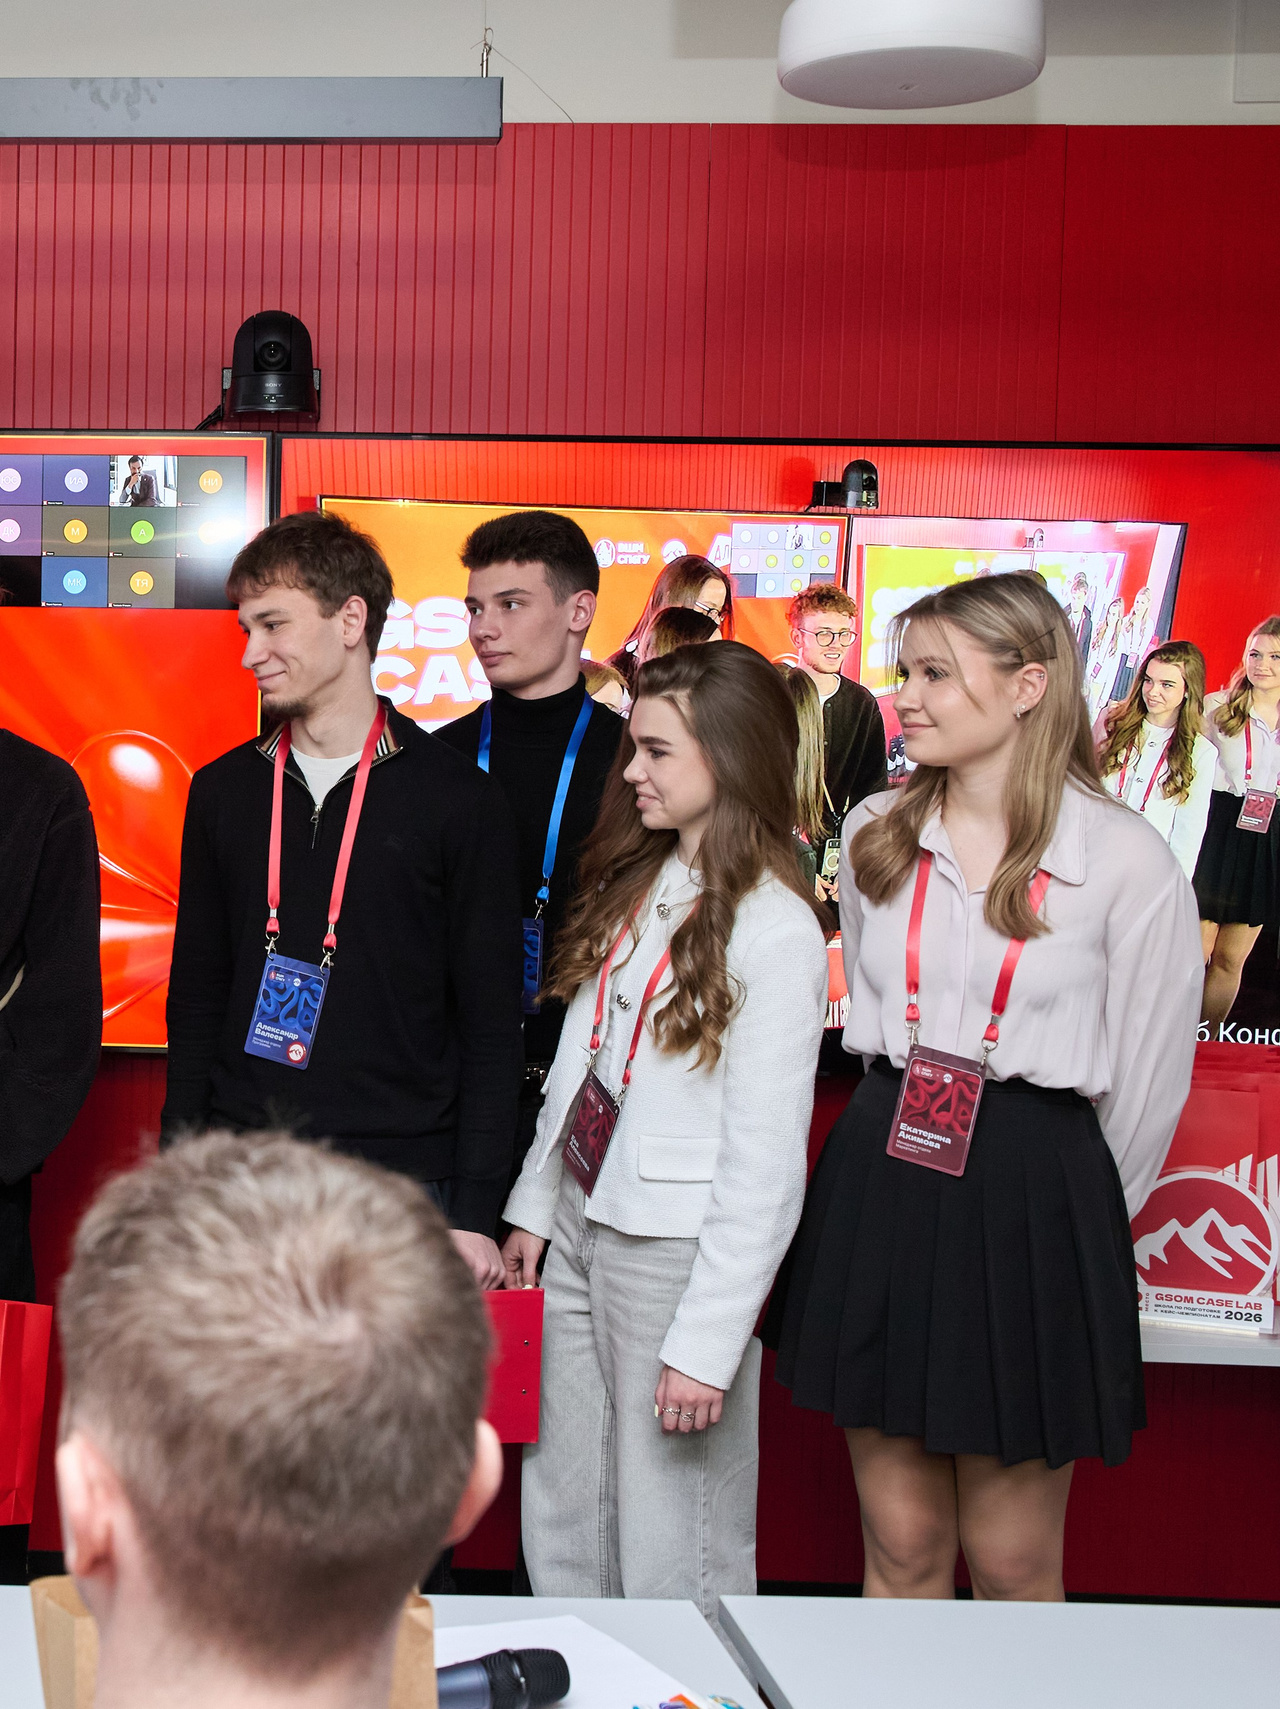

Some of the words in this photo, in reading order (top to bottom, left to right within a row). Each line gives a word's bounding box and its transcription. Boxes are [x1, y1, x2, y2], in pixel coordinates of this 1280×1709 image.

[69, 476, 84, 485] ИА
[204, 477, 218, 486] НИ
[2, 526, 15, 536] ДК
[67, 578, 82, 587] МК
[135, 578, 149, 587] ТЯ
[256, 1021, 299, 1041] Александр
[900, 1122, 952, 1145] Екатерина
[898, 1130, 941, 1150] Акимова
[1155, 1292, 1194, 1304] GSOM
[1196, 1296, 1234, 1308] CASE
[1235, 1300, 1263, 1311] LAB
[1160, 1309, 1221, 1319] КЕЙС-ЧЕМПИОНАТАМ
[1183, 1306, 1221, 1314] ПОДГОТОВКЕ
[1224, 1310, 1263, 1323] 2026
